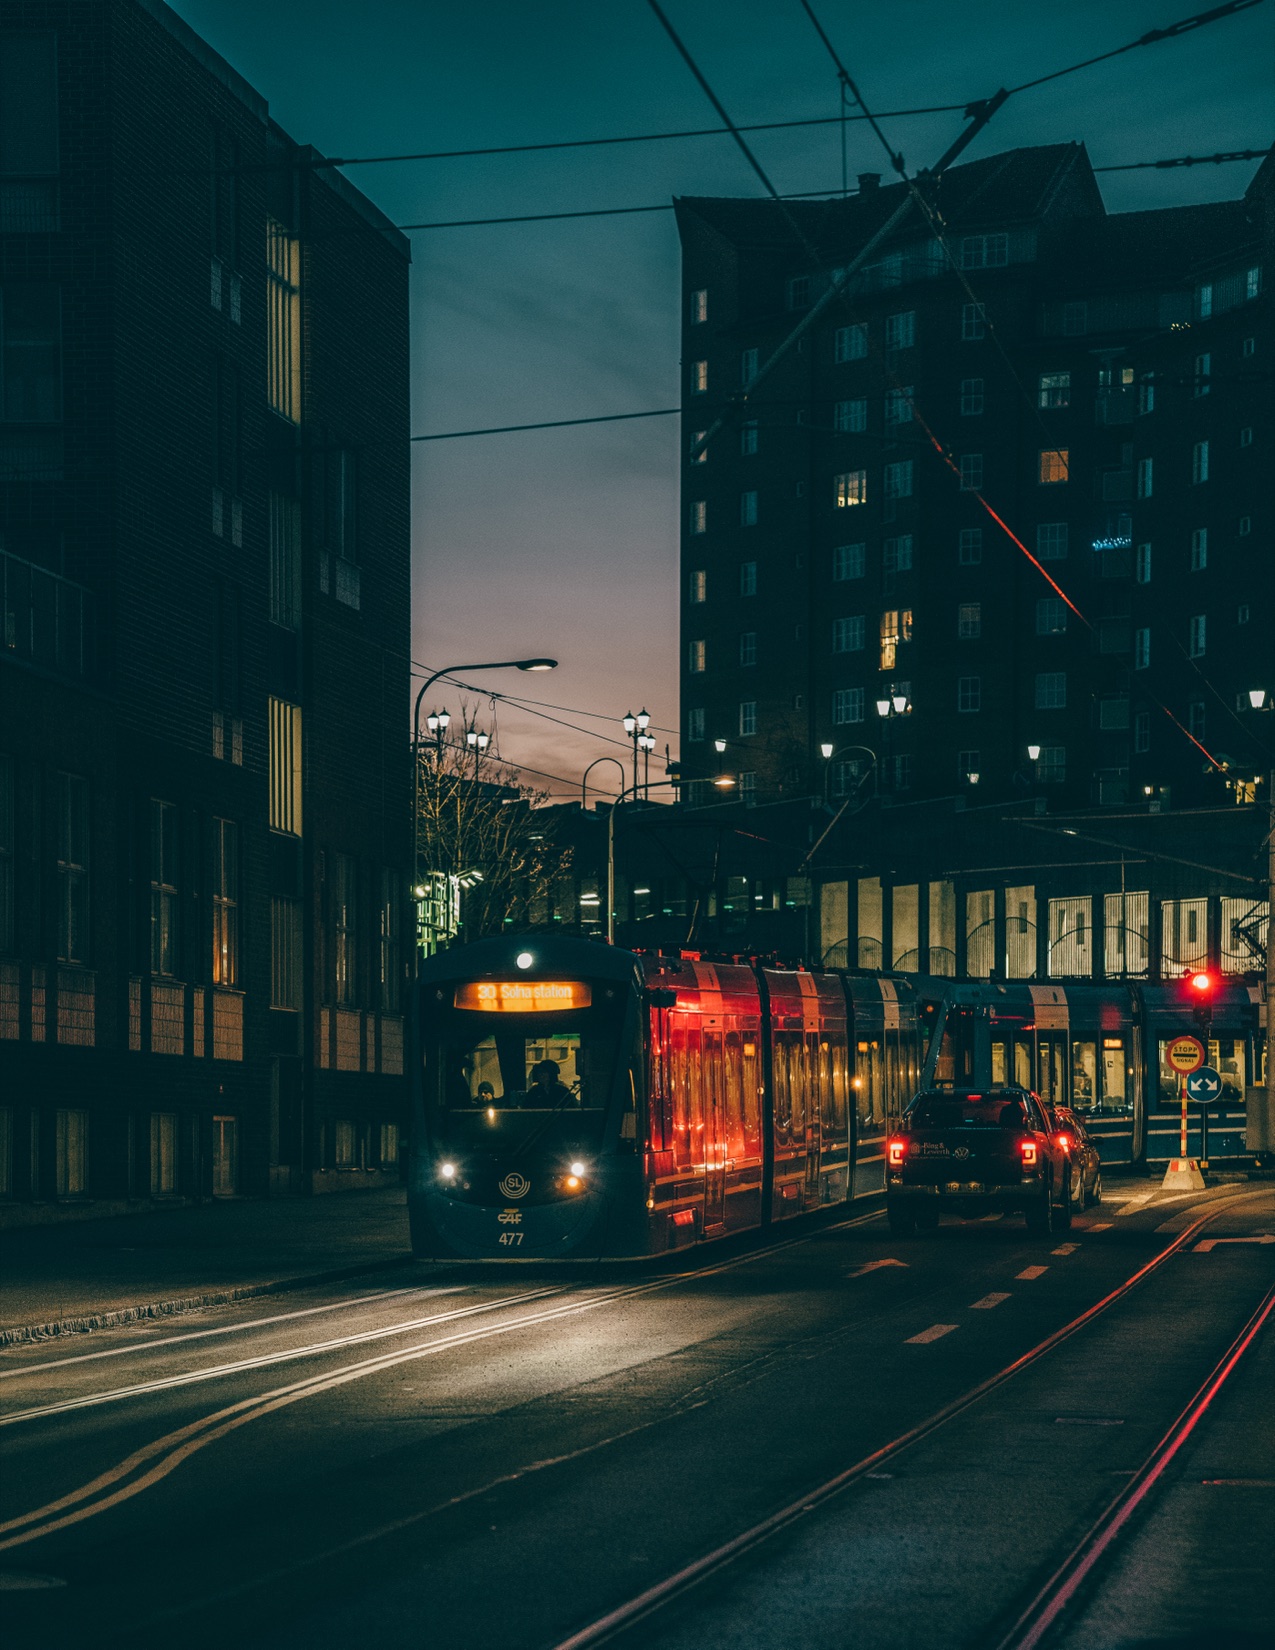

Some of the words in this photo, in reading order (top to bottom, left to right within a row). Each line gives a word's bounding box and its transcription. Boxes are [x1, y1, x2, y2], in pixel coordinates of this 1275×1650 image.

[478, 985, 496, 999] 30
[501, 985, 532, 999] Solna
[534, 984, 572, 999] station
[508, 1177, 521, 1188] SL
[498, 1232, 524, 1245] 477
